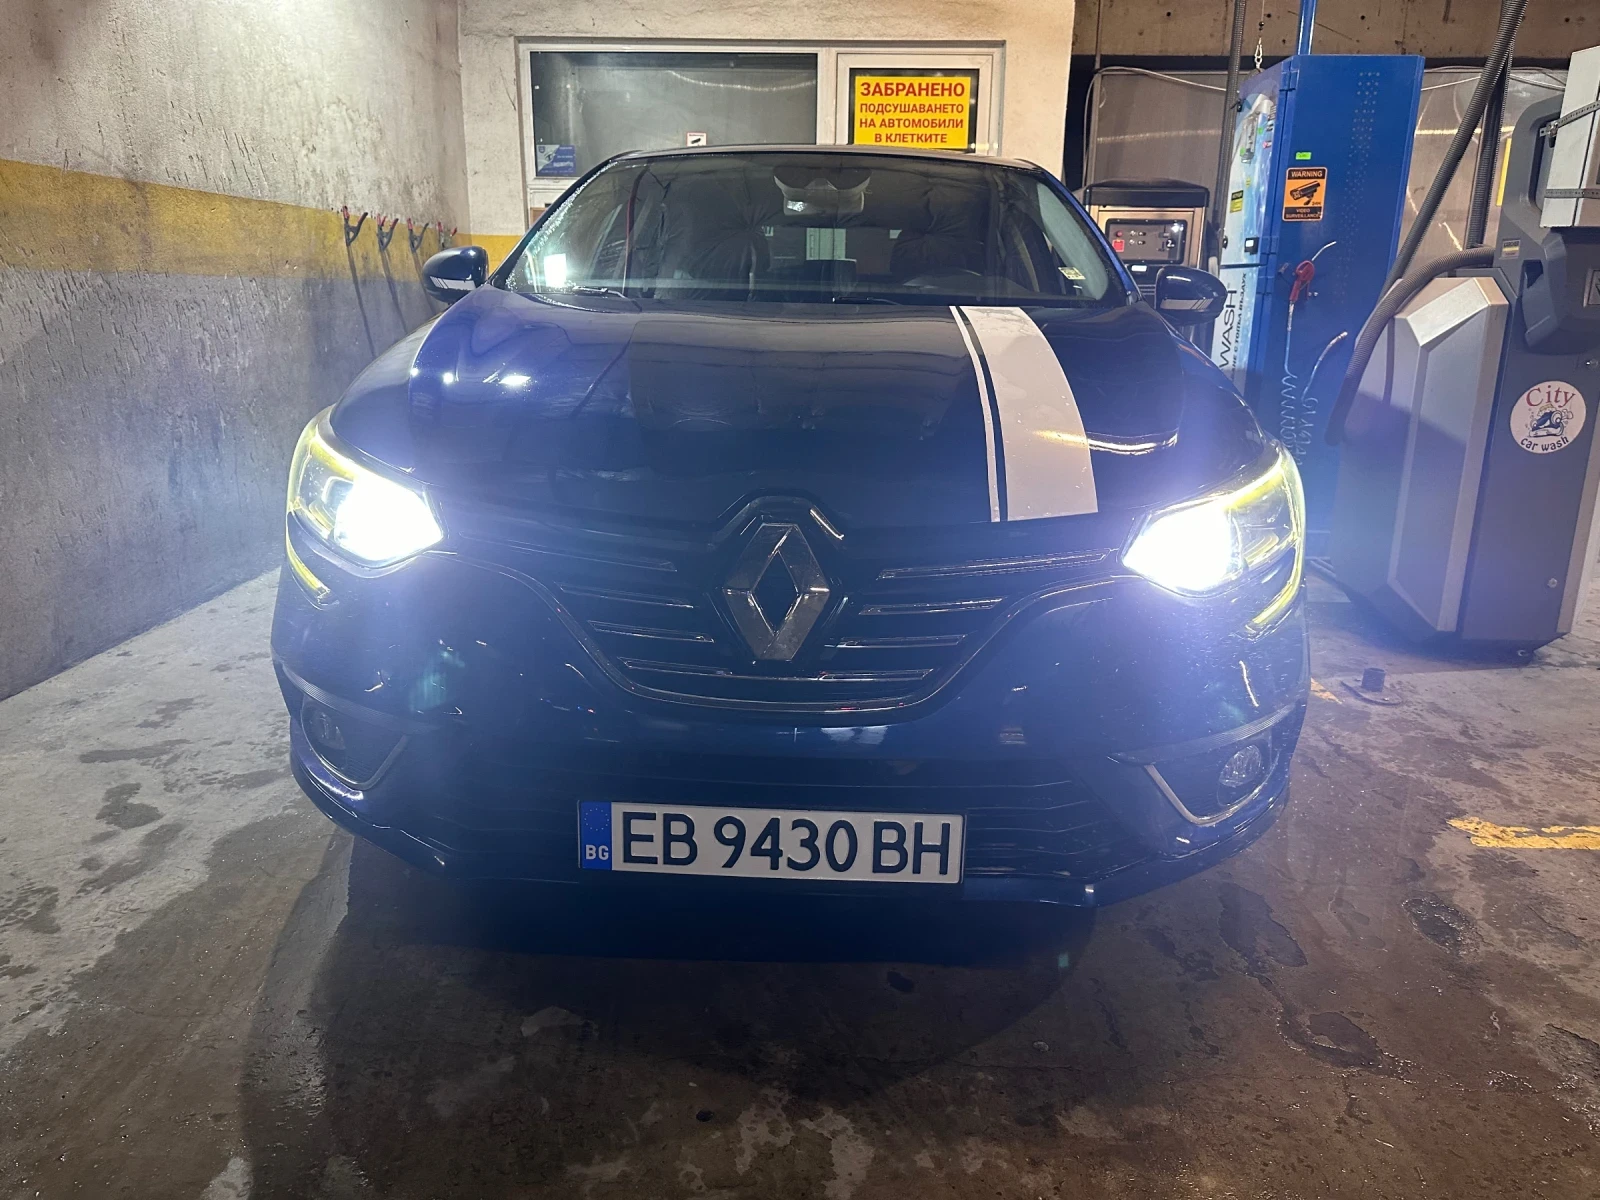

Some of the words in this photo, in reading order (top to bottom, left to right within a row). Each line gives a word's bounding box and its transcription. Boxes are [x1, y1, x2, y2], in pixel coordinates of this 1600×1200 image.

[860, 82, 965, 97] ЗАБРАНЕНО
[860, 103, 964, 115] ПОДСУШАВАНЕТО
[859, 118, 876, 128] НА
[879, 118, 963, 129] АВТОМОБИЛИ
[874, 133, 882, 142] В
[885, 133, 947, 143] КЛЕТКИТЕ
[1219, 290, 1237, 368] WASH
[1526, 385, 1576, 408] City
[1520, 438, 1538, 451] car
[1541, 436, 1569, 452] wash
[585, 844, 609, 860] BG
[713, 815, 858, 873] 9430
